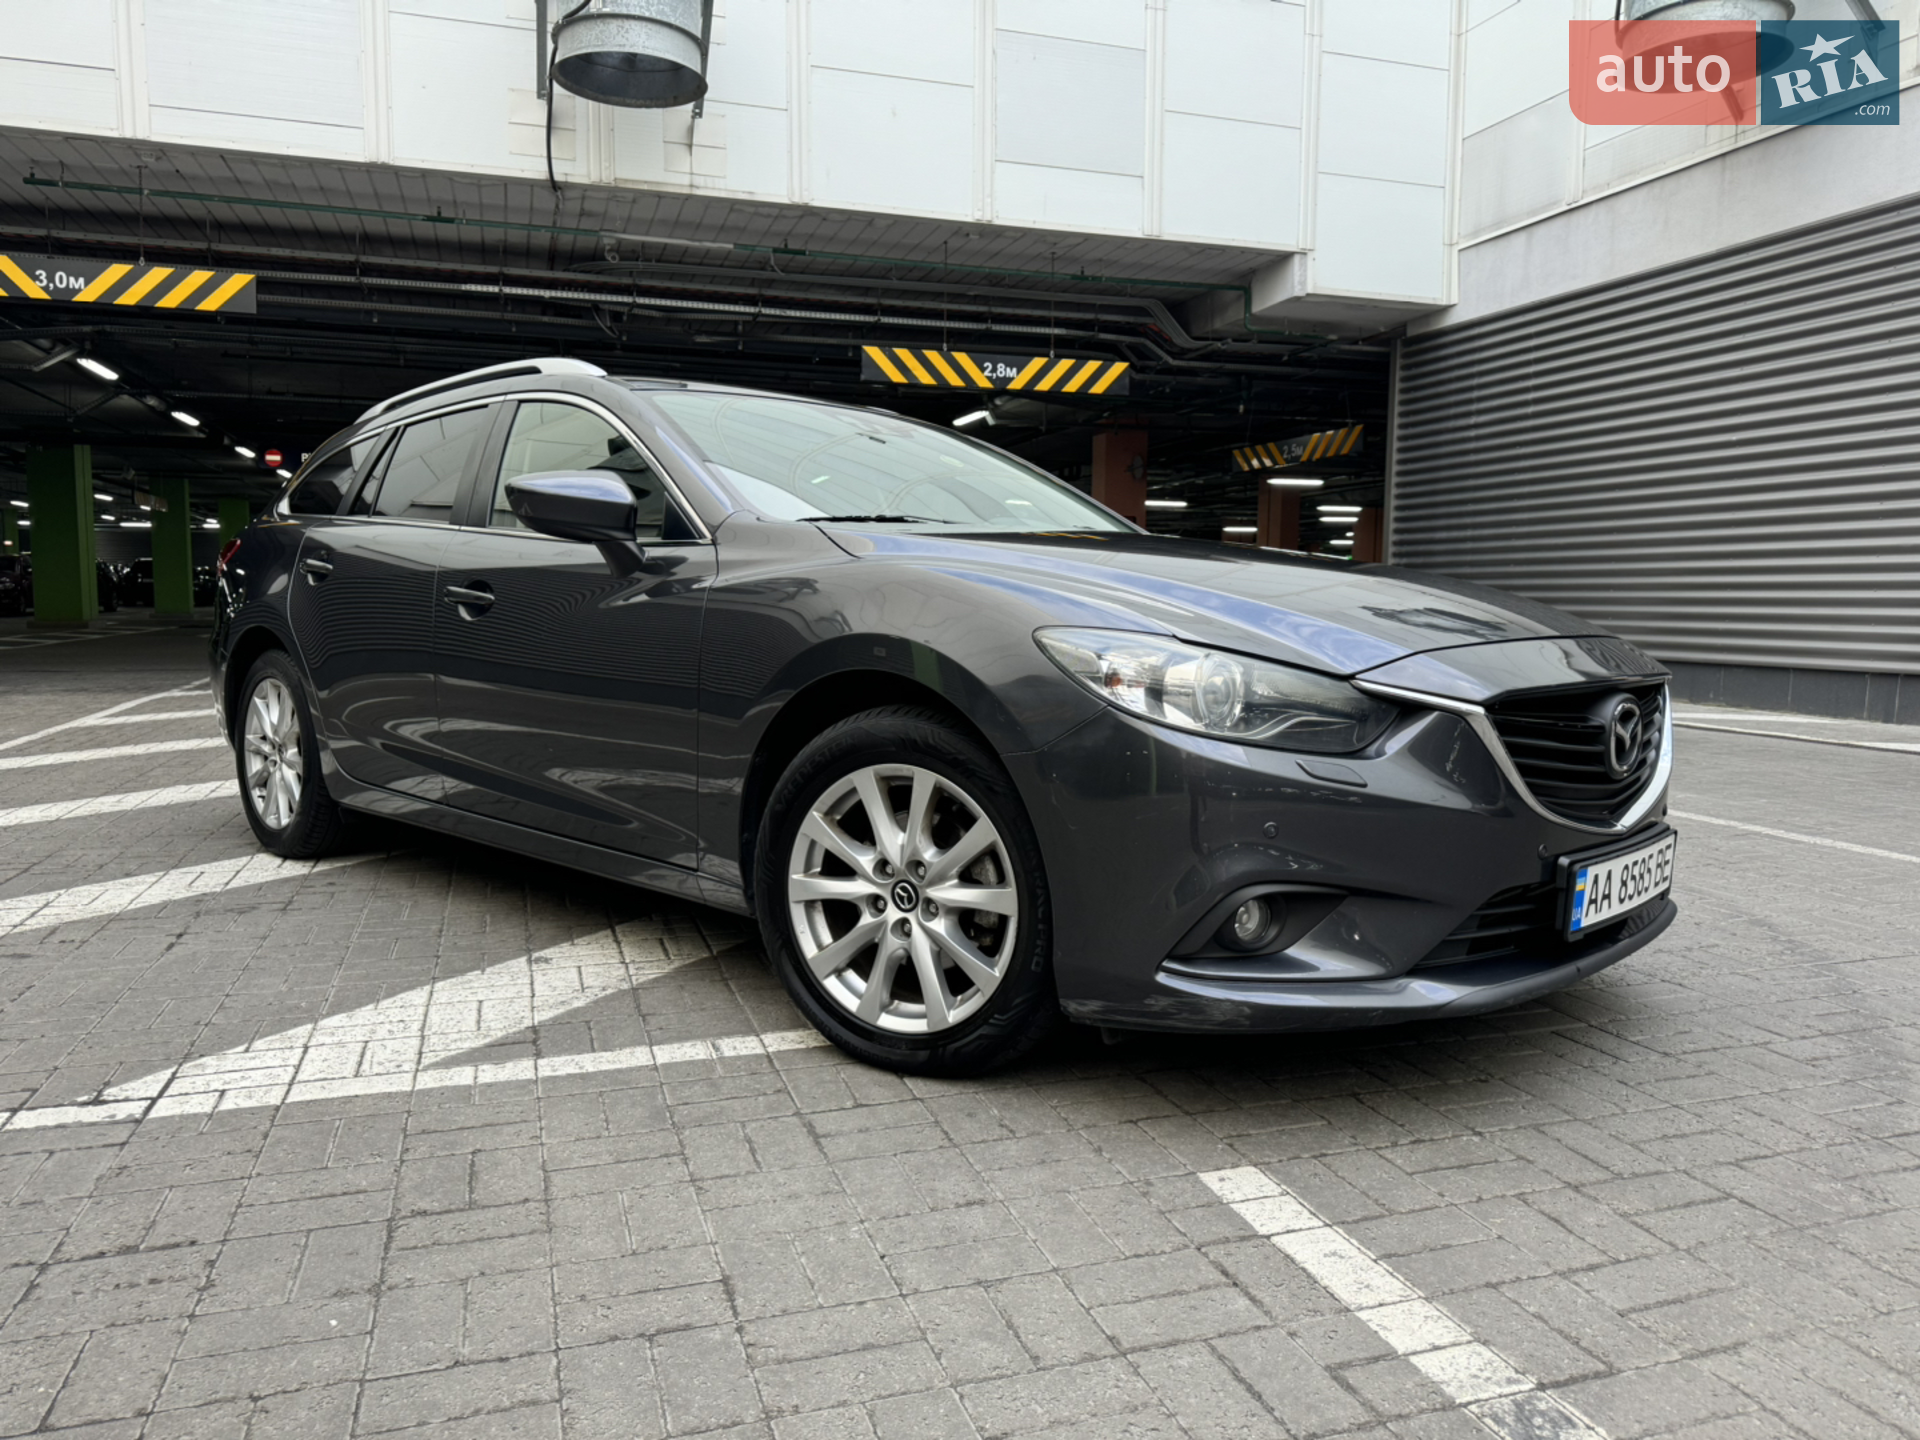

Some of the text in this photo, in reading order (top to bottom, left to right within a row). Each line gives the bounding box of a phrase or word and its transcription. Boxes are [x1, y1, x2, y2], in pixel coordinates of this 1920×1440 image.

[35, 269, 85, 291] 3,0м
[983, 361, 1017, 380] 2,8м
[1585, 843, 1672, 918] AA 8585 BE
